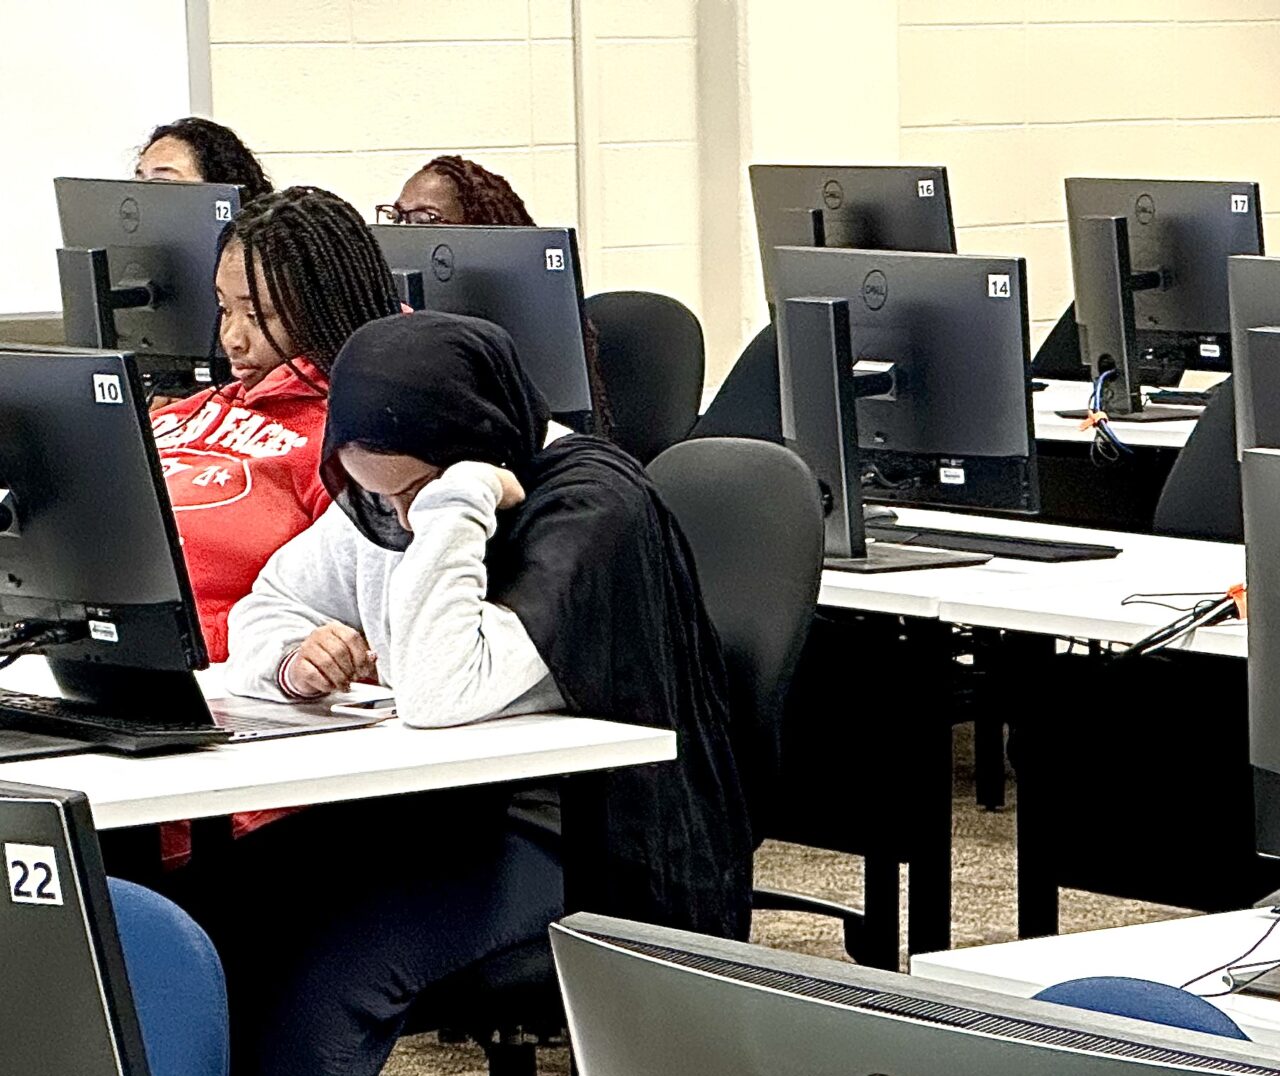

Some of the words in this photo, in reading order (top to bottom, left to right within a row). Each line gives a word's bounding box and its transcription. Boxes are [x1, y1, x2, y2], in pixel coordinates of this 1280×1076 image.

[920, 185, 932, 196] 16
[217, 205, 230, 218] 12
[1234, 200, 1246, 211] 17
[547, 254, 563, 268] 13
[992, 281, 1008, 295] 14
[98, 382, 119, 400] 10
[11, 860, 57, 900] 22
